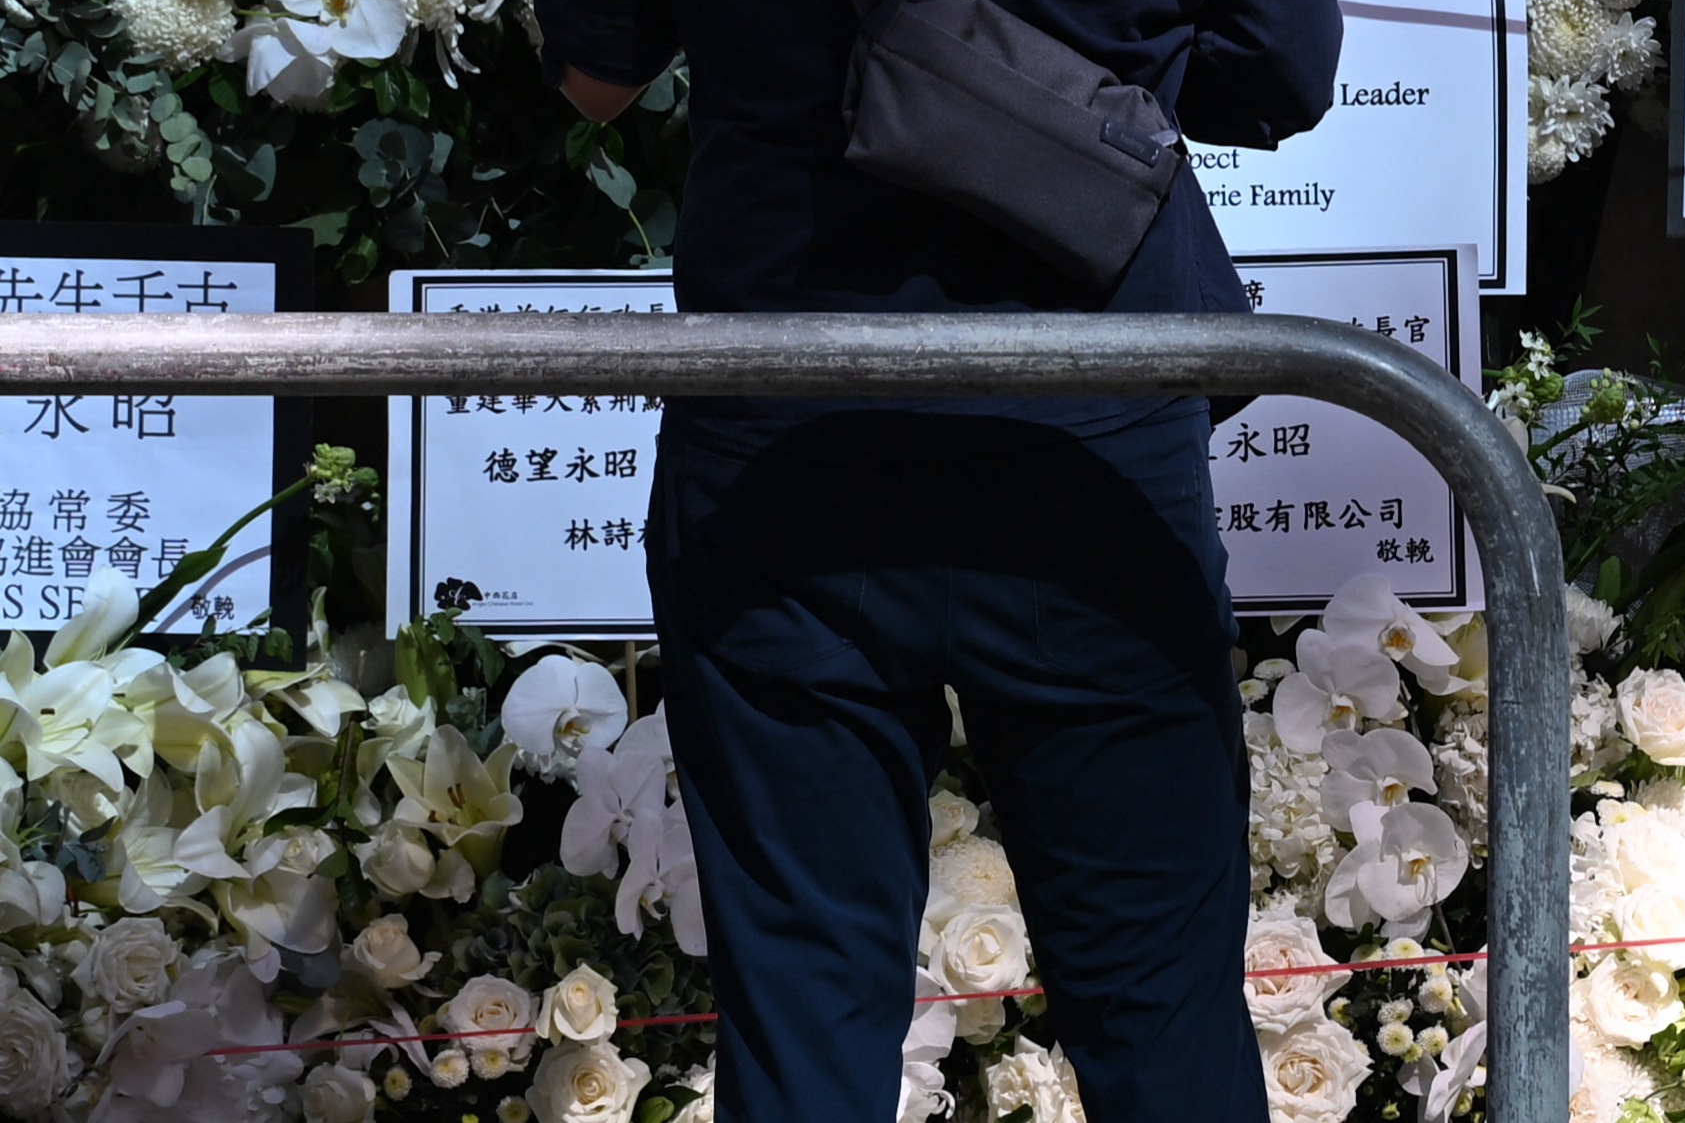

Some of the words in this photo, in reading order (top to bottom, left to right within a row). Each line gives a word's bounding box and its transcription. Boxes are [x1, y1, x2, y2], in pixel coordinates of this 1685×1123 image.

[1340, 81, 1430, 107] Leader
[1249, 182, 1336, 211] Family
[483, 446, 638, 483] 德望永昭
[0, 534, 189, 579] 進會會長
[1376, 537, 1435, 564] 敬輓
[190, 593, 236, 621] 敬輓
